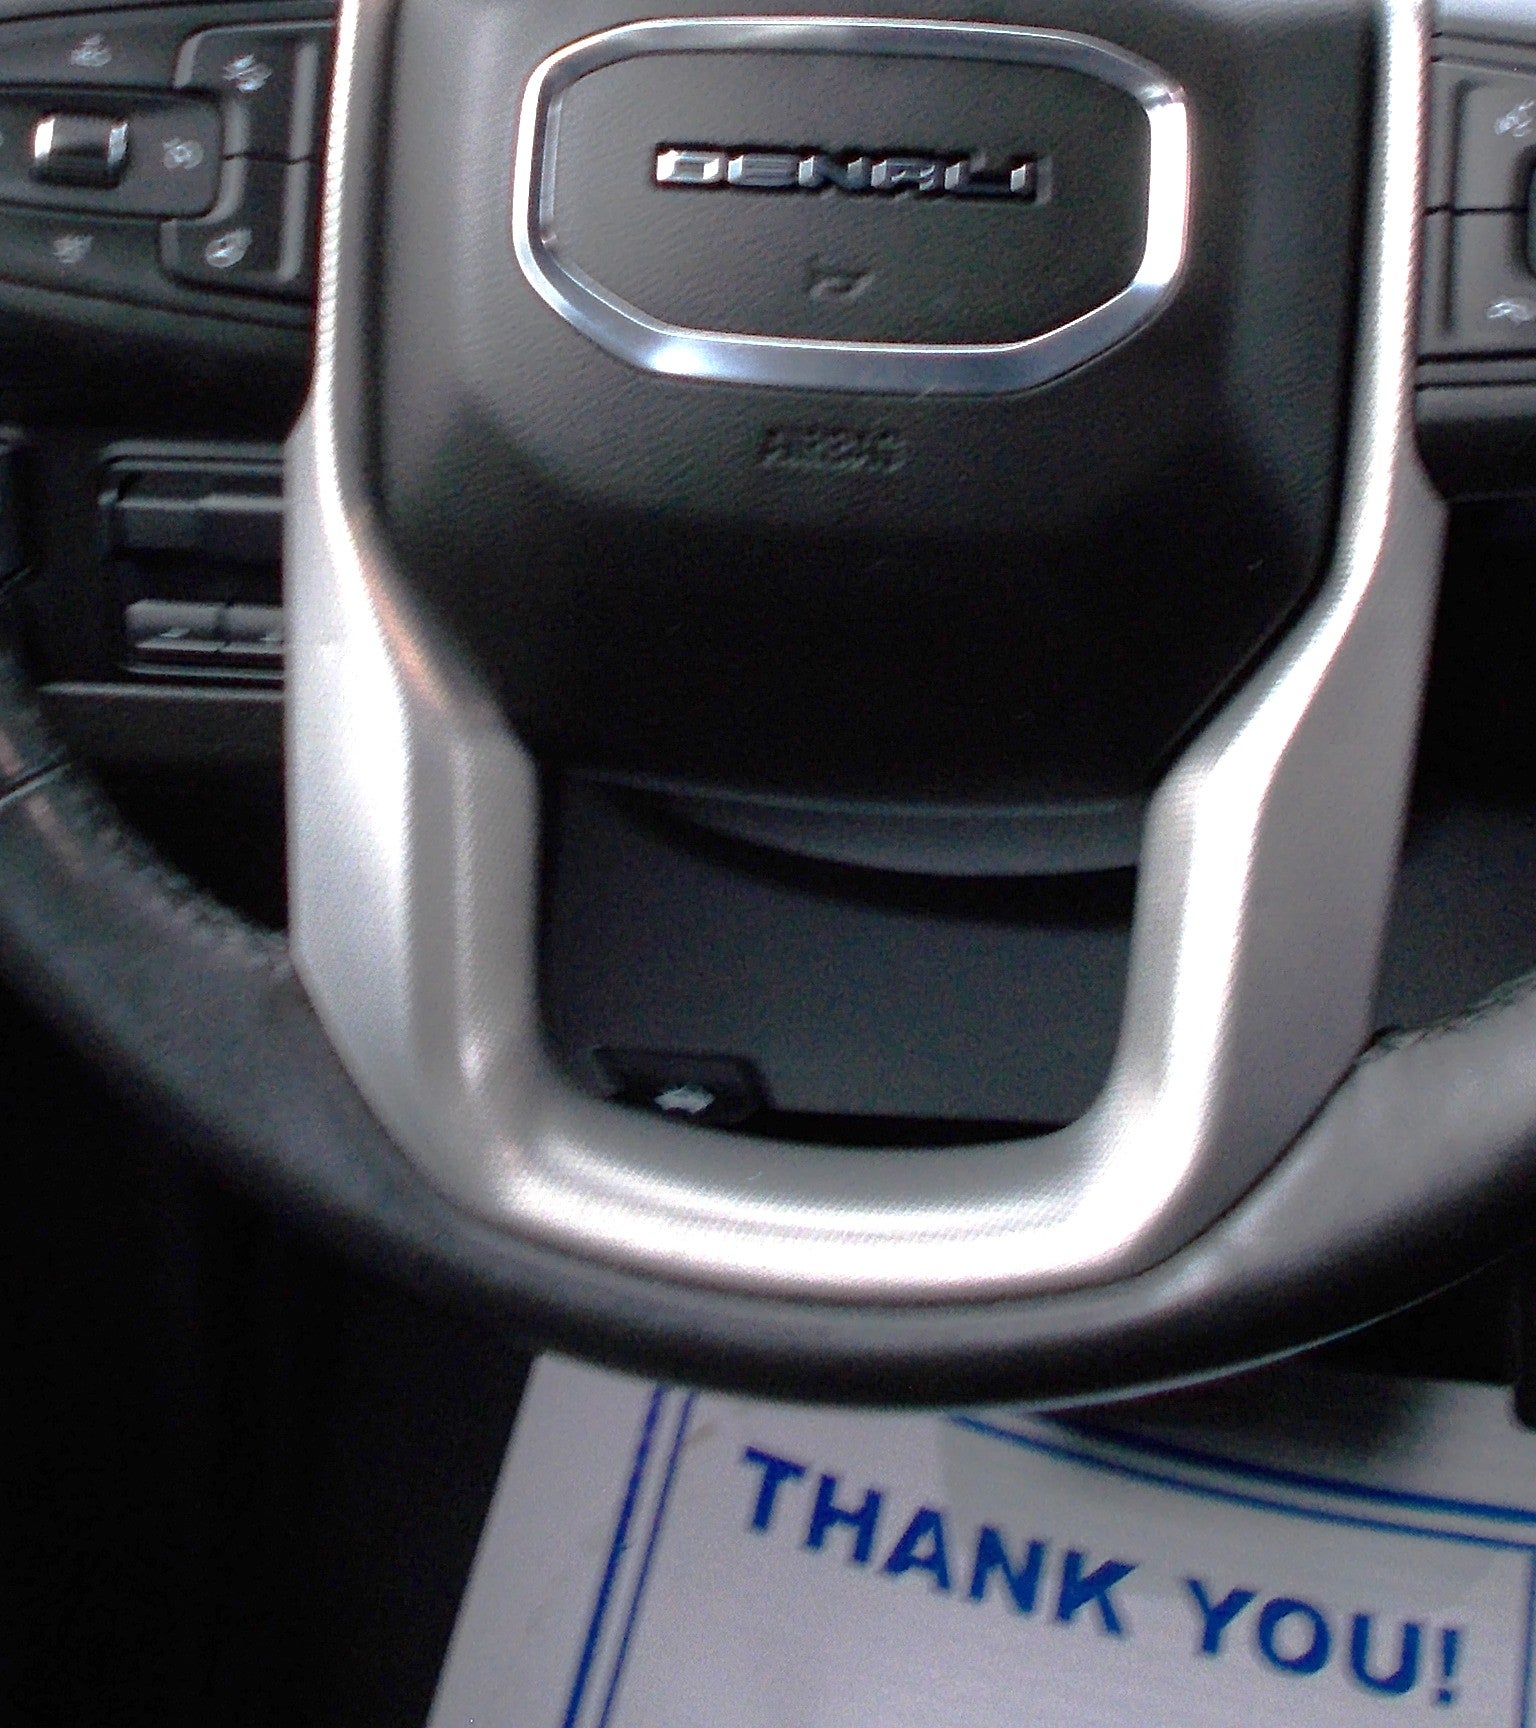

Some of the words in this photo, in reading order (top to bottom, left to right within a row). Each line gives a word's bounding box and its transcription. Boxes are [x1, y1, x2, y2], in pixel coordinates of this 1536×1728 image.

[654, 146, 1036, 198] DENALI
[742, 1445, 1140, 1639] THANK
[1183, 1576, 1462, 1707] YOU!
